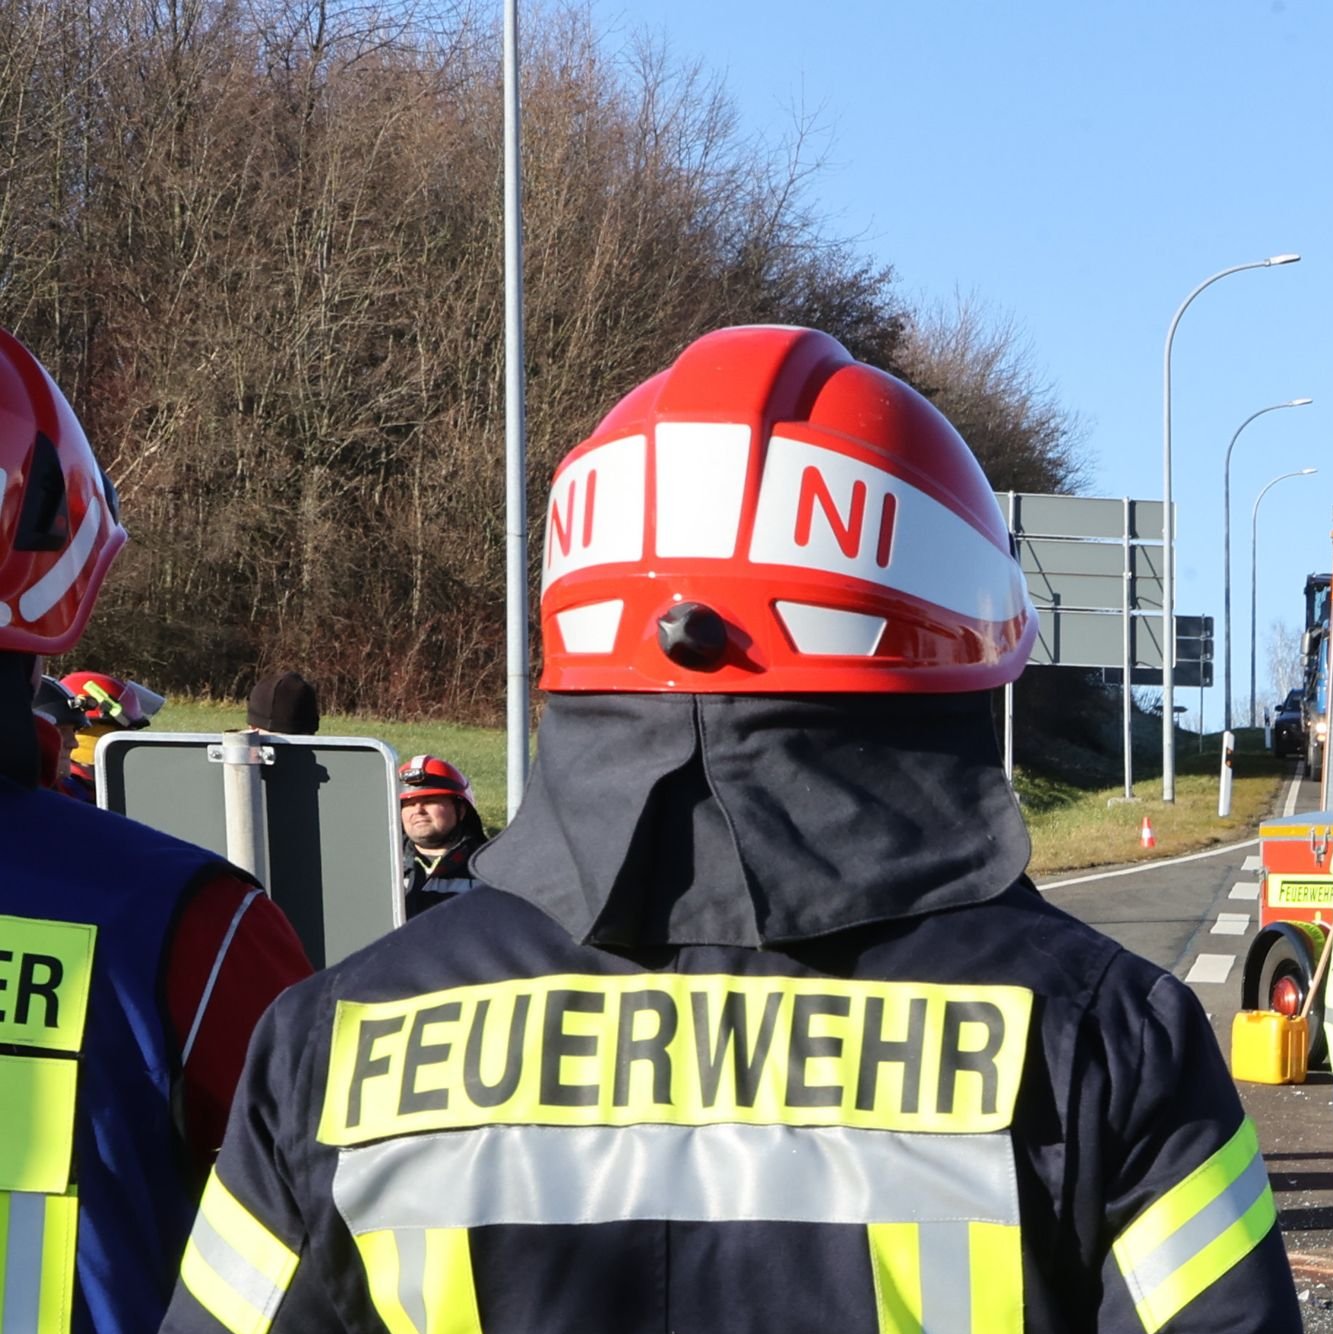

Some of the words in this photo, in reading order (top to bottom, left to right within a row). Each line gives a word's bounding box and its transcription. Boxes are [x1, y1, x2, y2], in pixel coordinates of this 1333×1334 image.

[548, 468, 598, 570] NI
[794, 464, 897, 570] NI
[344, 990, 1006, 1129] FEUERWEHR
